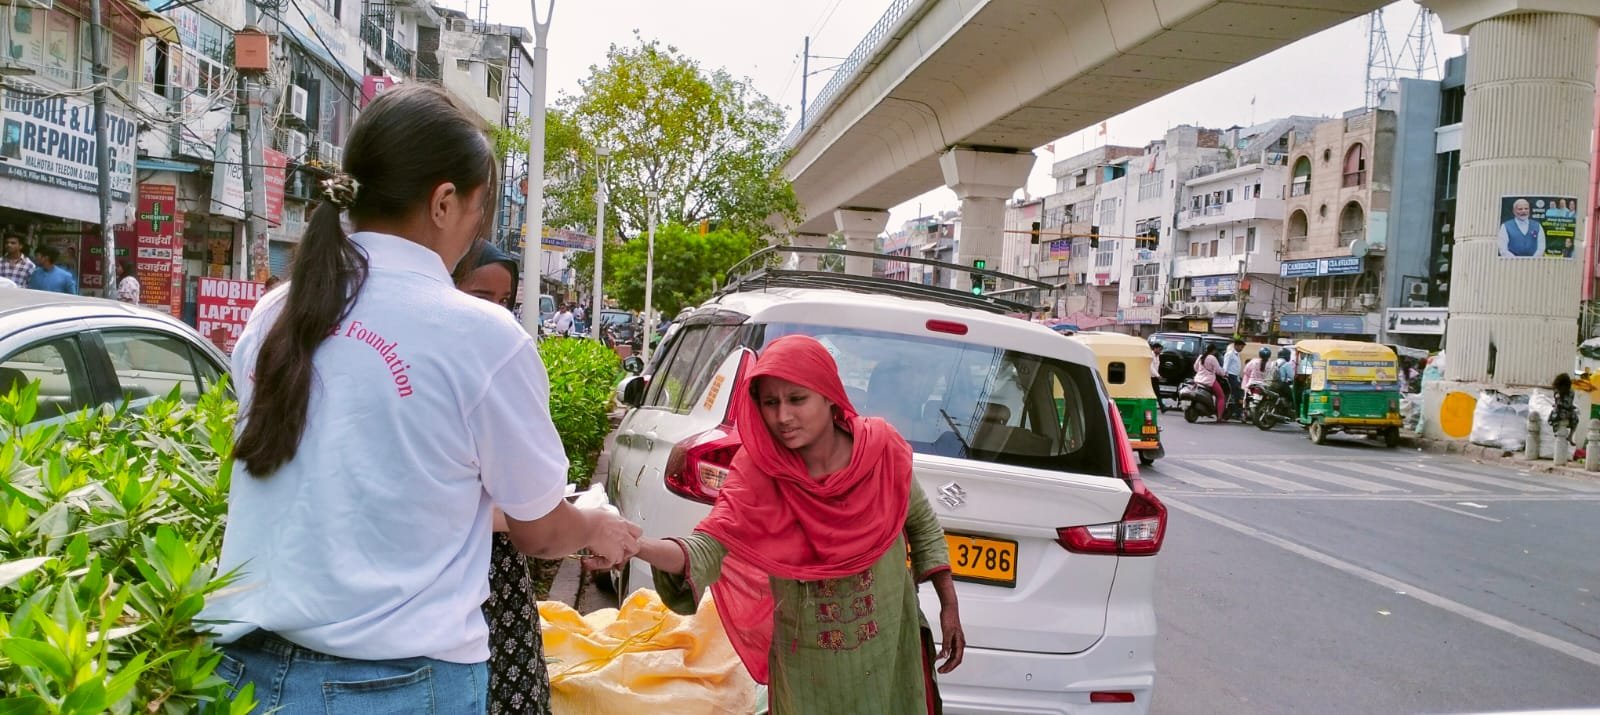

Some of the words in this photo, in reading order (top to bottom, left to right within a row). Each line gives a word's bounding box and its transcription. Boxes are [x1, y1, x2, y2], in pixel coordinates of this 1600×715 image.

[5, 89, 67, 127] MOBILE
[70, 106, 80, 131] &
[23, 121, 117, 172] REPAIRIG
[25, 154, 54, 171] MALHOTRA
[55, 162, 79, 179] TELECOM
[201, 280, 265, 301] MOBILE
[199, 304, 252, 322] LAPTO
[345, 320, 414, 398] Foundation
[957, 544, 1010, 572] 3786
